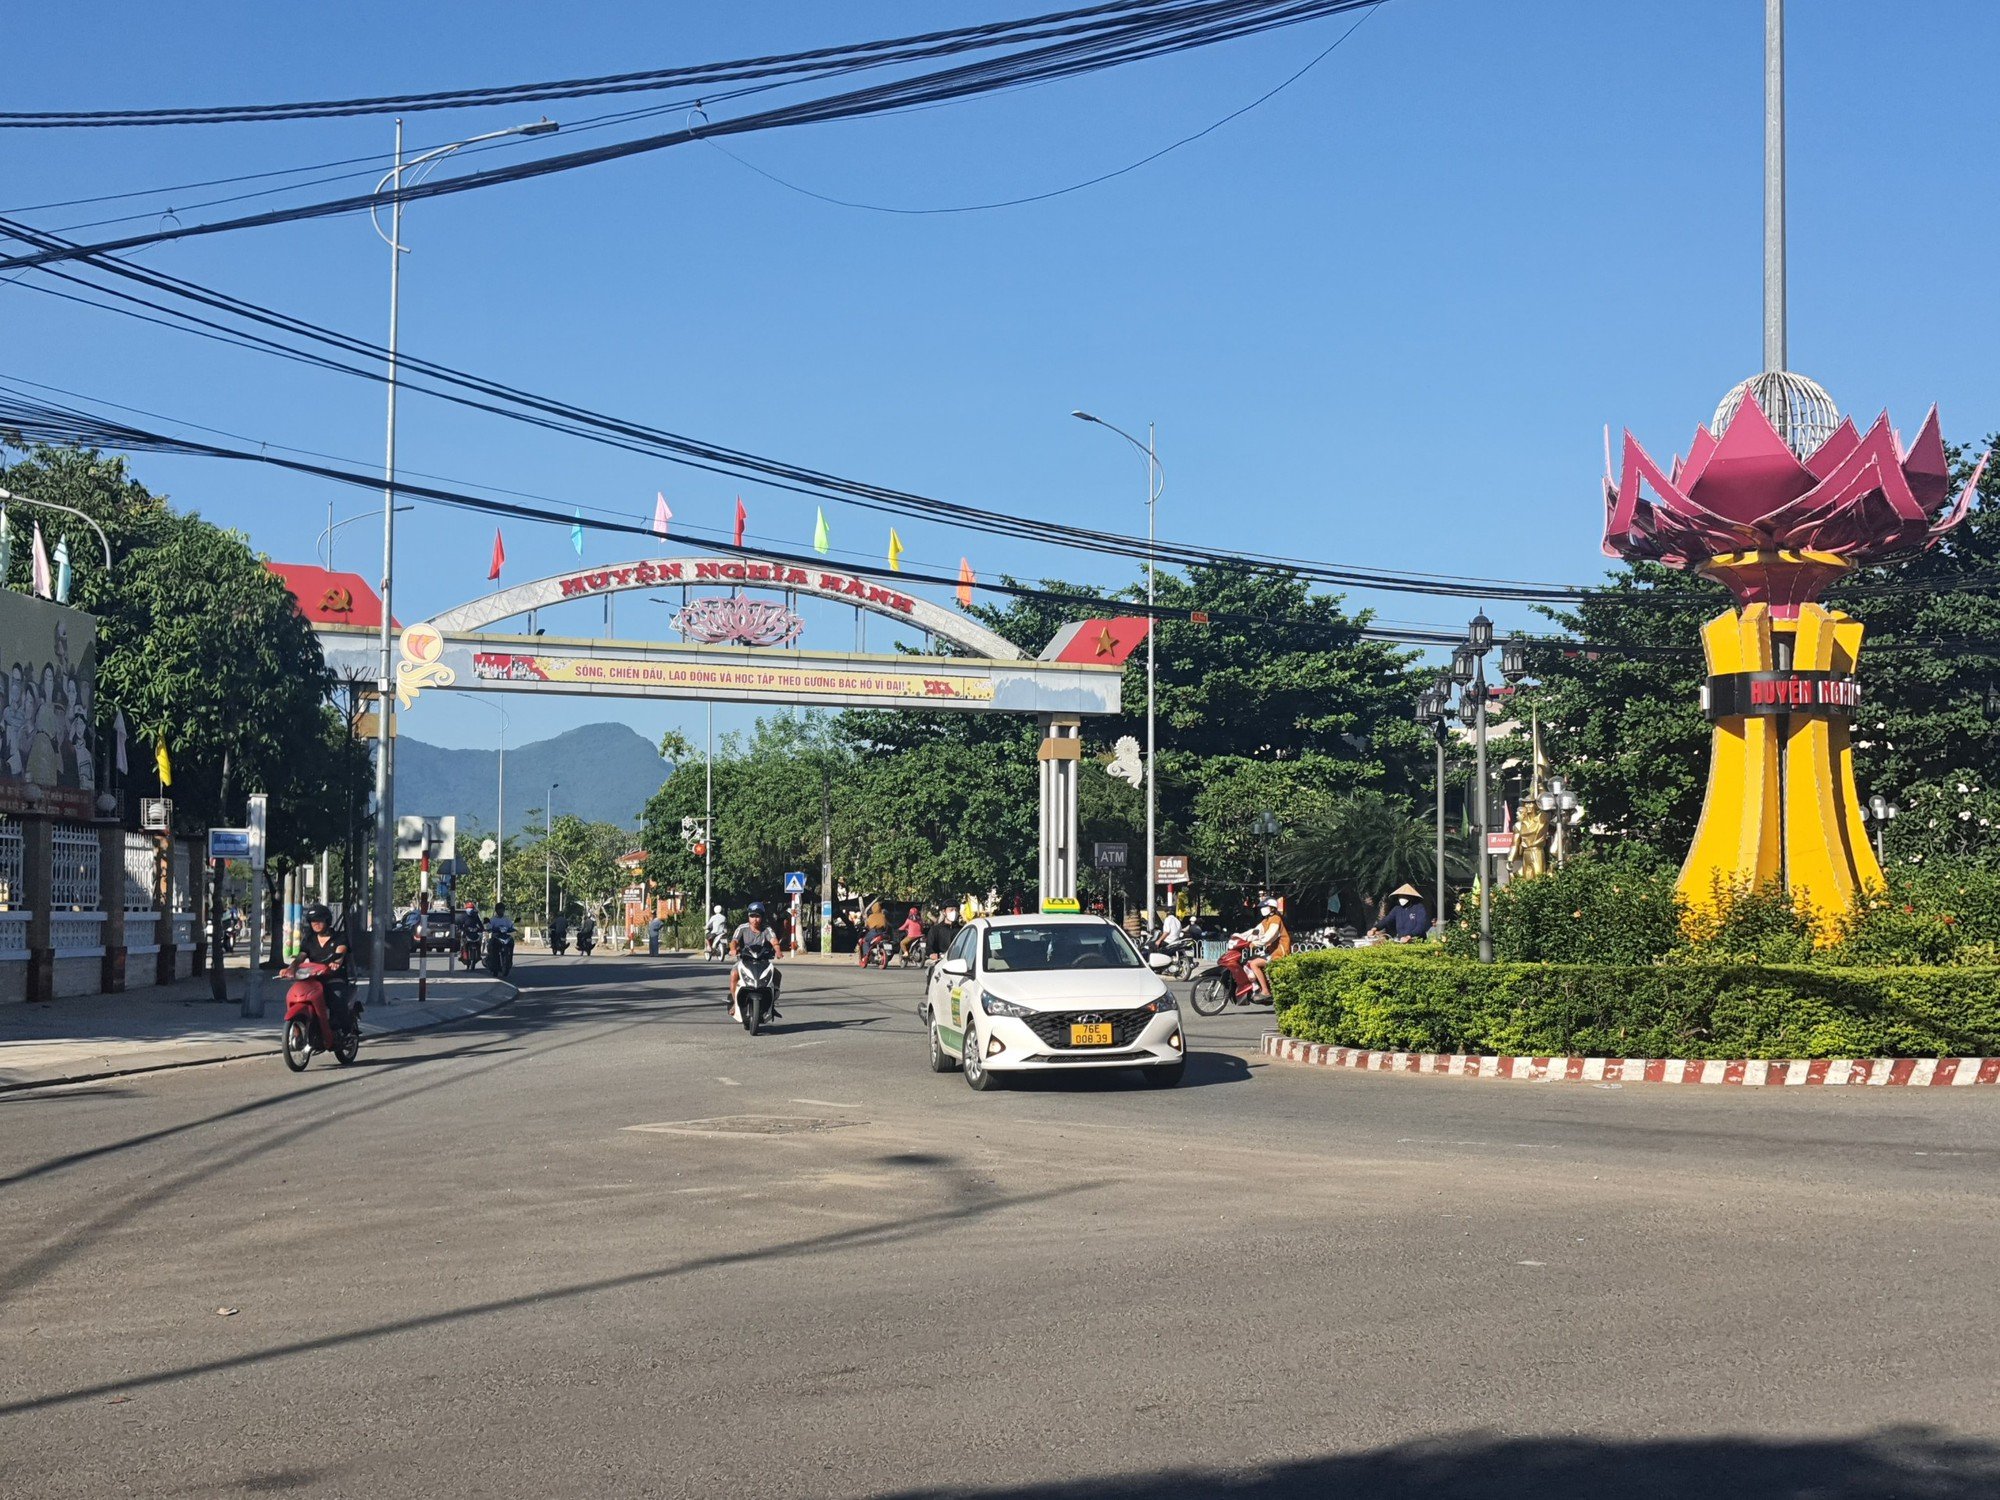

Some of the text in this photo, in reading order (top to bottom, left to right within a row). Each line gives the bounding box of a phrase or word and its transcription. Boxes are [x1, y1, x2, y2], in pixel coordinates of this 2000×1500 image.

[559, 560, 683, 596] HUYỆN
[610, 665, 640, 679] CHIẾN
[669, 670, 687, 681] LAO
[689, 670, 717, 683] ĐỘNG
[719, 671, 732, 683] VÀ
[735, 673, 754, 685] HỌC
[757, 673, 775, 686] TẬP
[778, 675, 801, 686] THEO
[804, 676, 836, 688] GƯƠNG
[838, 677, 857, 688] BÁC
[1751, 674, 1812, 709] HUYỆN
[1100, 851, 1124, 863] ATM
[1159, 856, 1182, 868] CẤM
[1082, 1024, 1101, 1034] 76E
